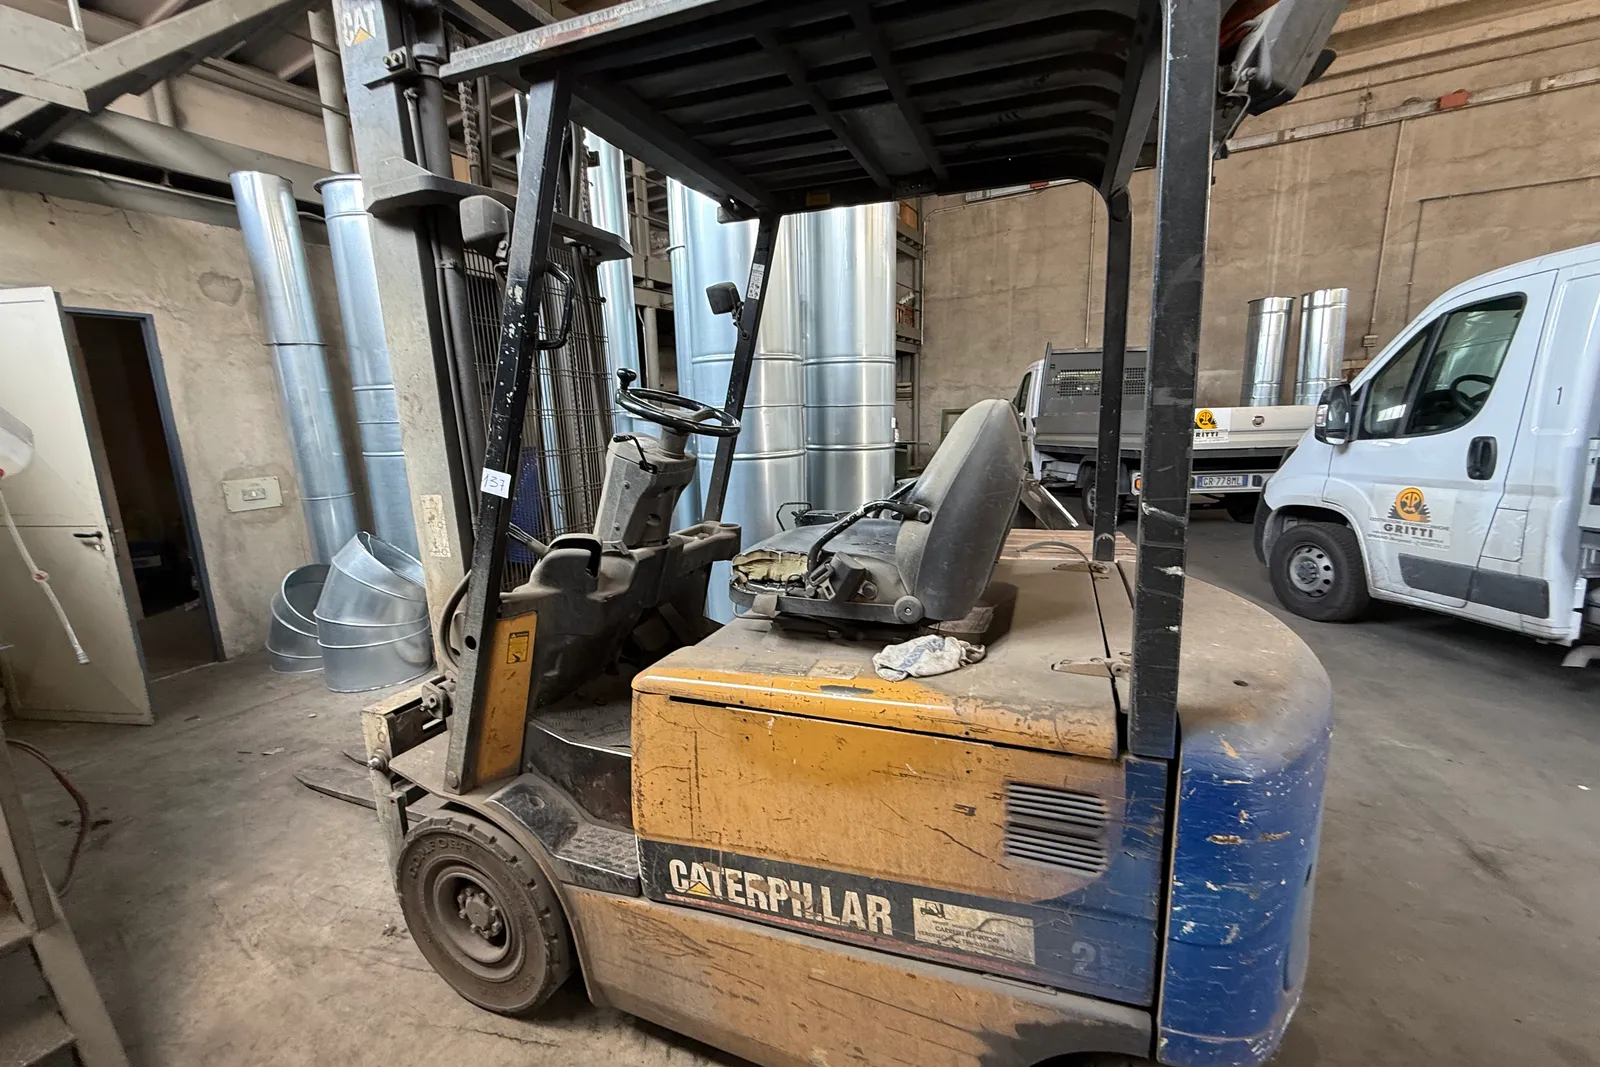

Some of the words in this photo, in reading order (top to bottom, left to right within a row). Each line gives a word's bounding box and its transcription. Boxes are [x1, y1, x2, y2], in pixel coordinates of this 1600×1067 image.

[342, 2, 377, 47] CAT
[483, 473, 505, 492] 137
[1383, 523, 1433, 538] GRITTI
[668, 858, 894, 936] CATERPILLAR
